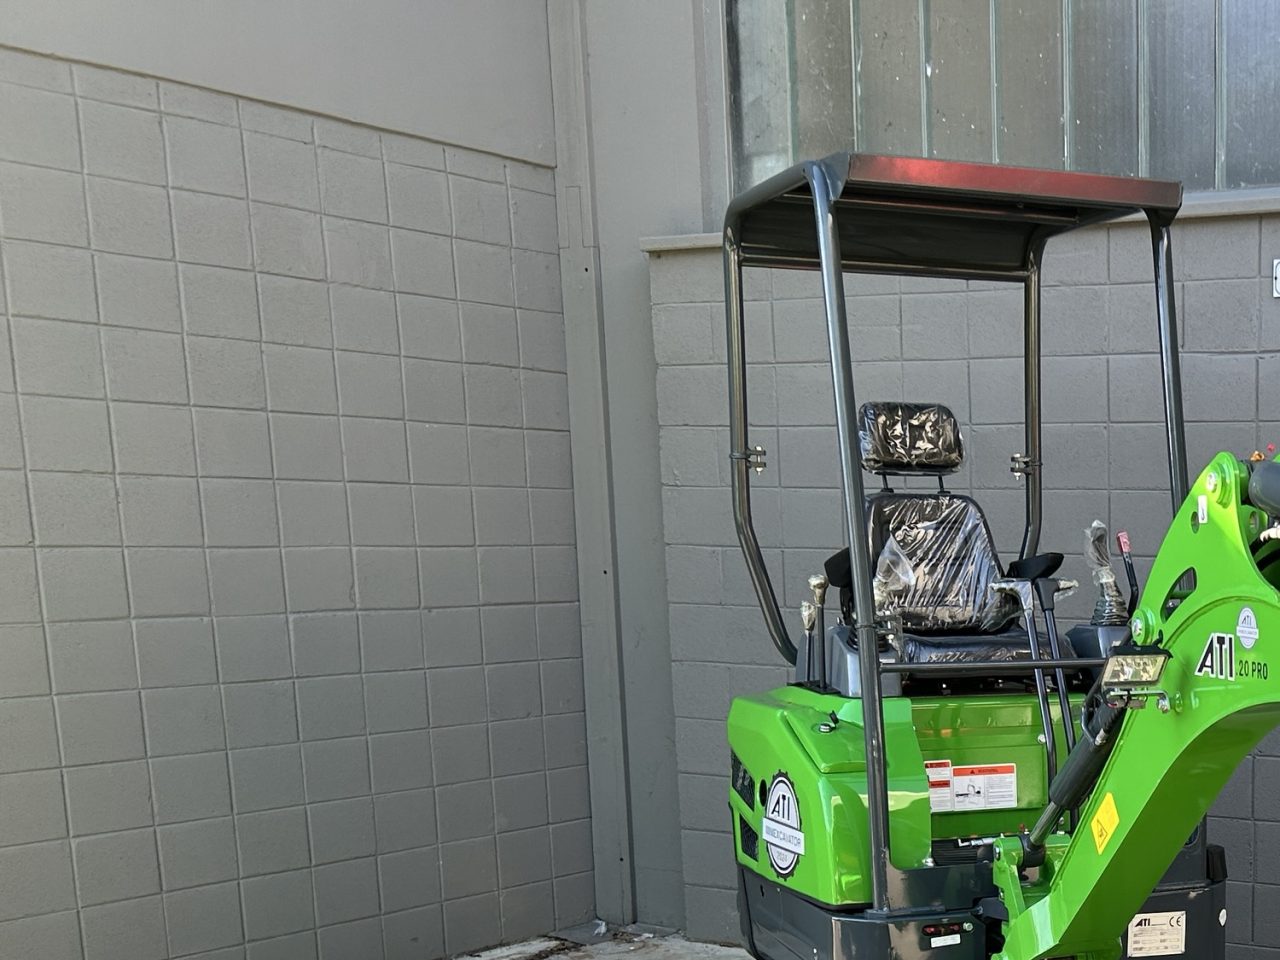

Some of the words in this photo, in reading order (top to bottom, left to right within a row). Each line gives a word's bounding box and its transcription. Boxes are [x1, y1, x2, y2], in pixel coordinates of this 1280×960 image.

[1241, 615, 1252, 626] ATI
[1196, 634, 1235, 680] ATI
[1251, 661, 1268, 680] PRO
[771, 793, 791, 821] ATI
[764, 824, 801, 847] EXCAVATOR
[1135, 918, 1151, 928] ATI
